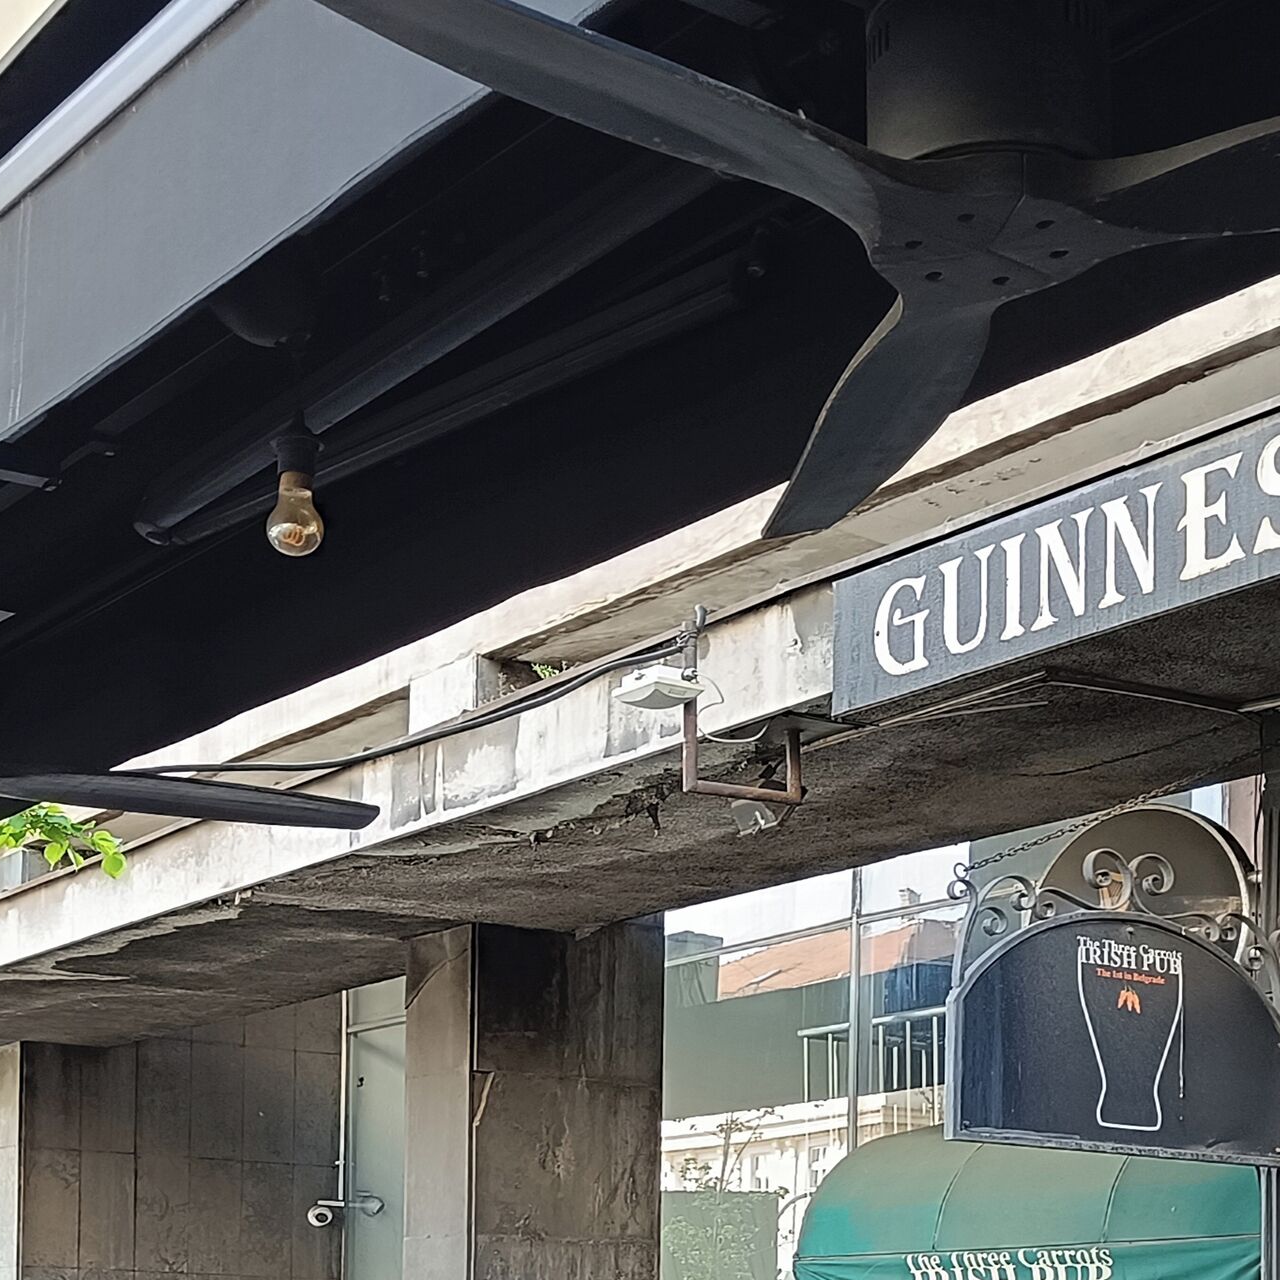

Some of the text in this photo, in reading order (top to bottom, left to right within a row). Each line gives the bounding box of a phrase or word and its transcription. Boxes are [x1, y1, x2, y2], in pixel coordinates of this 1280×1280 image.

[1076, 935, 1183, 961] The Three Carrots
[1080, 945, 1180, 976] IRISH PUB
[903, 1247, 1114, 1274] The Three Carrots
